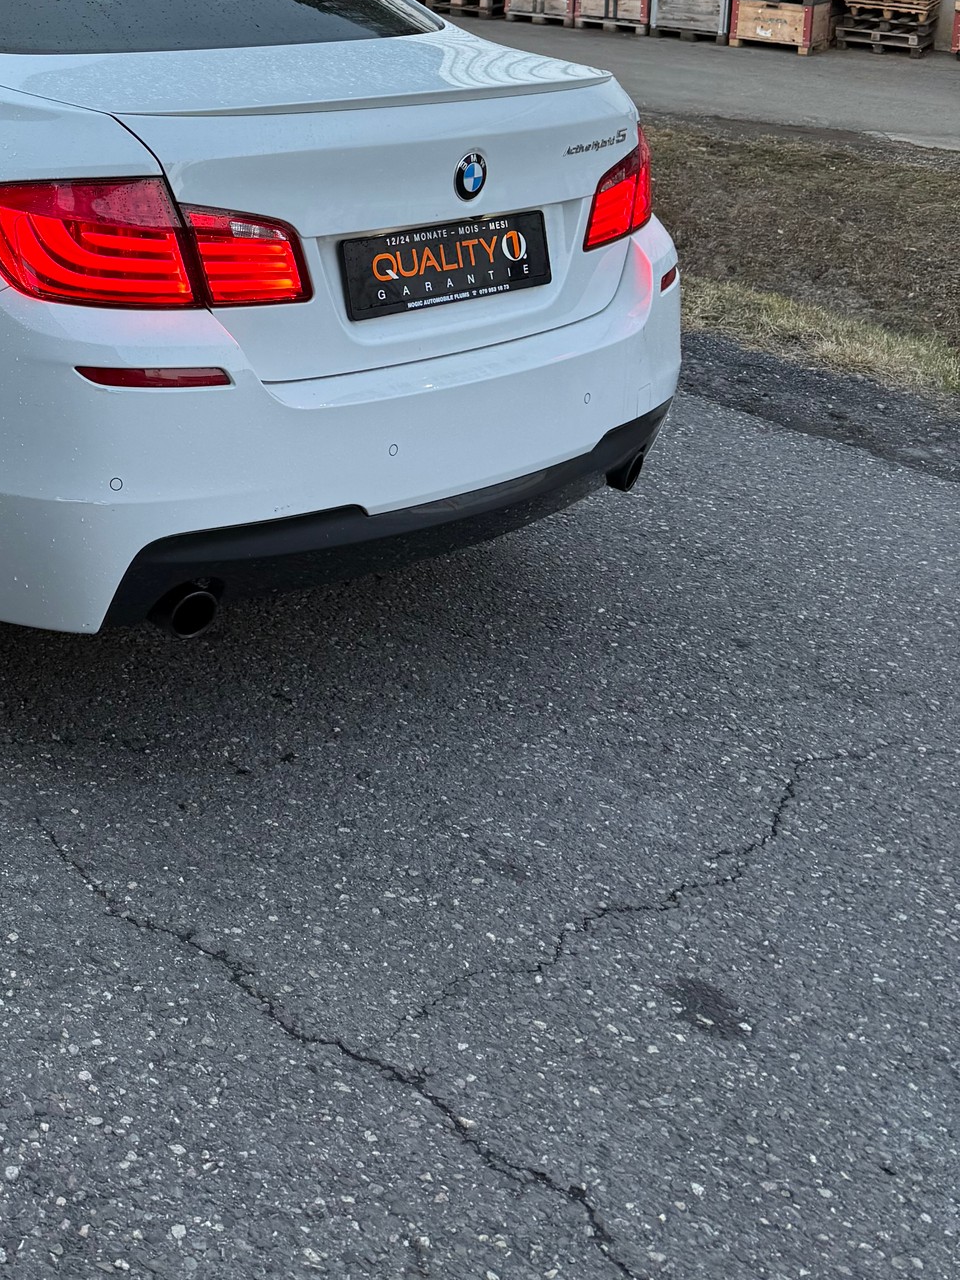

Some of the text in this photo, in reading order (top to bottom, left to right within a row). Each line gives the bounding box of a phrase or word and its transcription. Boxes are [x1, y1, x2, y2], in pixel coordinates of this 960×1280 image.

[615, 128, 628, 144] 5
[386, 236, 411, 246] 12/24
[413, 228, 448, 242] MONATE
[458, 224, 479, 235] MOIS
[489, 220, 509, 230] MESI
[371, 235, 498, 282] QUALITY
[378, 264, 530, 300] GARANTIE
